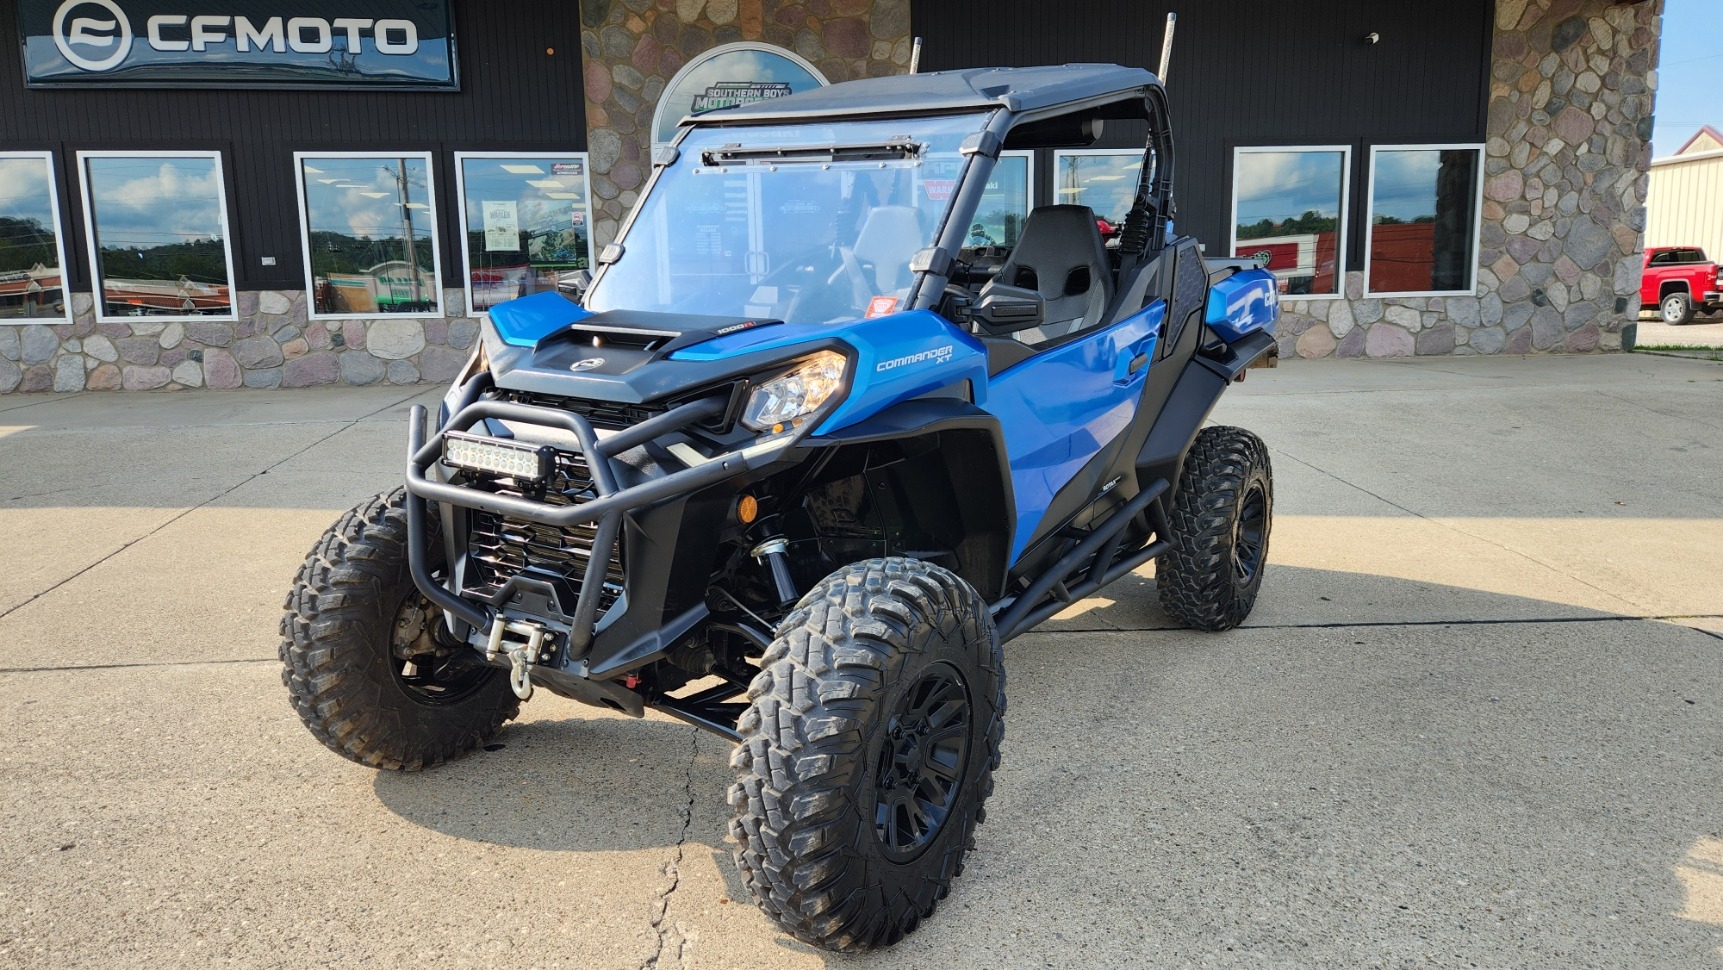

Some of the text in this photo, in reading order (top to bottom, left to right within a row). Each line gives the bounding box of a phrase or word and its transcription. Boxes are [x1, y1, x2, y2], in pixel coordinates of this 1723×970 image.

[147, 14, 419, 55] CFMOTO
[707, 88, 789, 98] SOUTHERN BOYS
[876, 345, 953, 372] COMMANDER
[936, 354, 953, 365] XT
